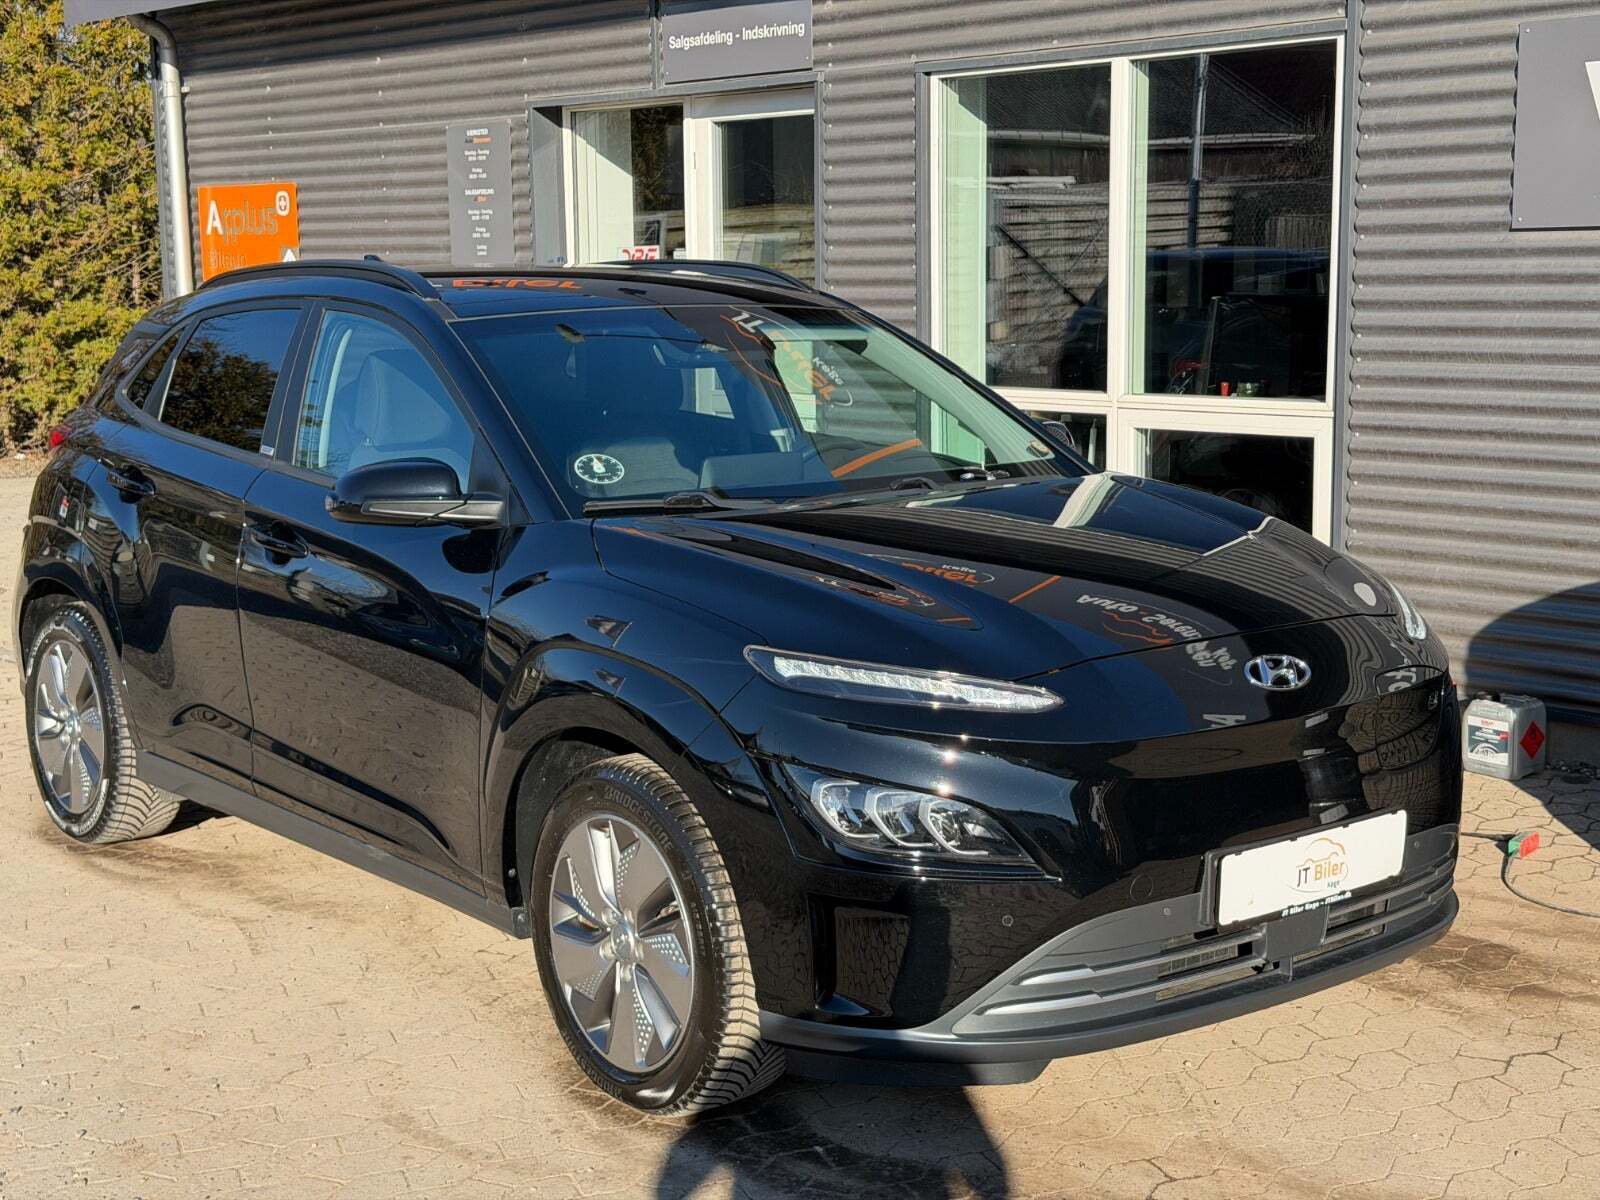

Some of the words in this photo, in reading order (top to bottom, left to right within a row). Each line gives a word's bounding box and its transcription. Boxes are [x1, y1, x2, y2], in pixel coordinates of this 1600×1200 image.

[668, 30, 733, 50] Salgsafdeling
[742, 21, 805, 40] Indskrivning
[206, 200, 279, 245] Applus
[604, 784, 674, 851] BRIDGESTONE
[1297, 866, 1311, 888] JT
[1315, 861, 1345, 880] Biler
